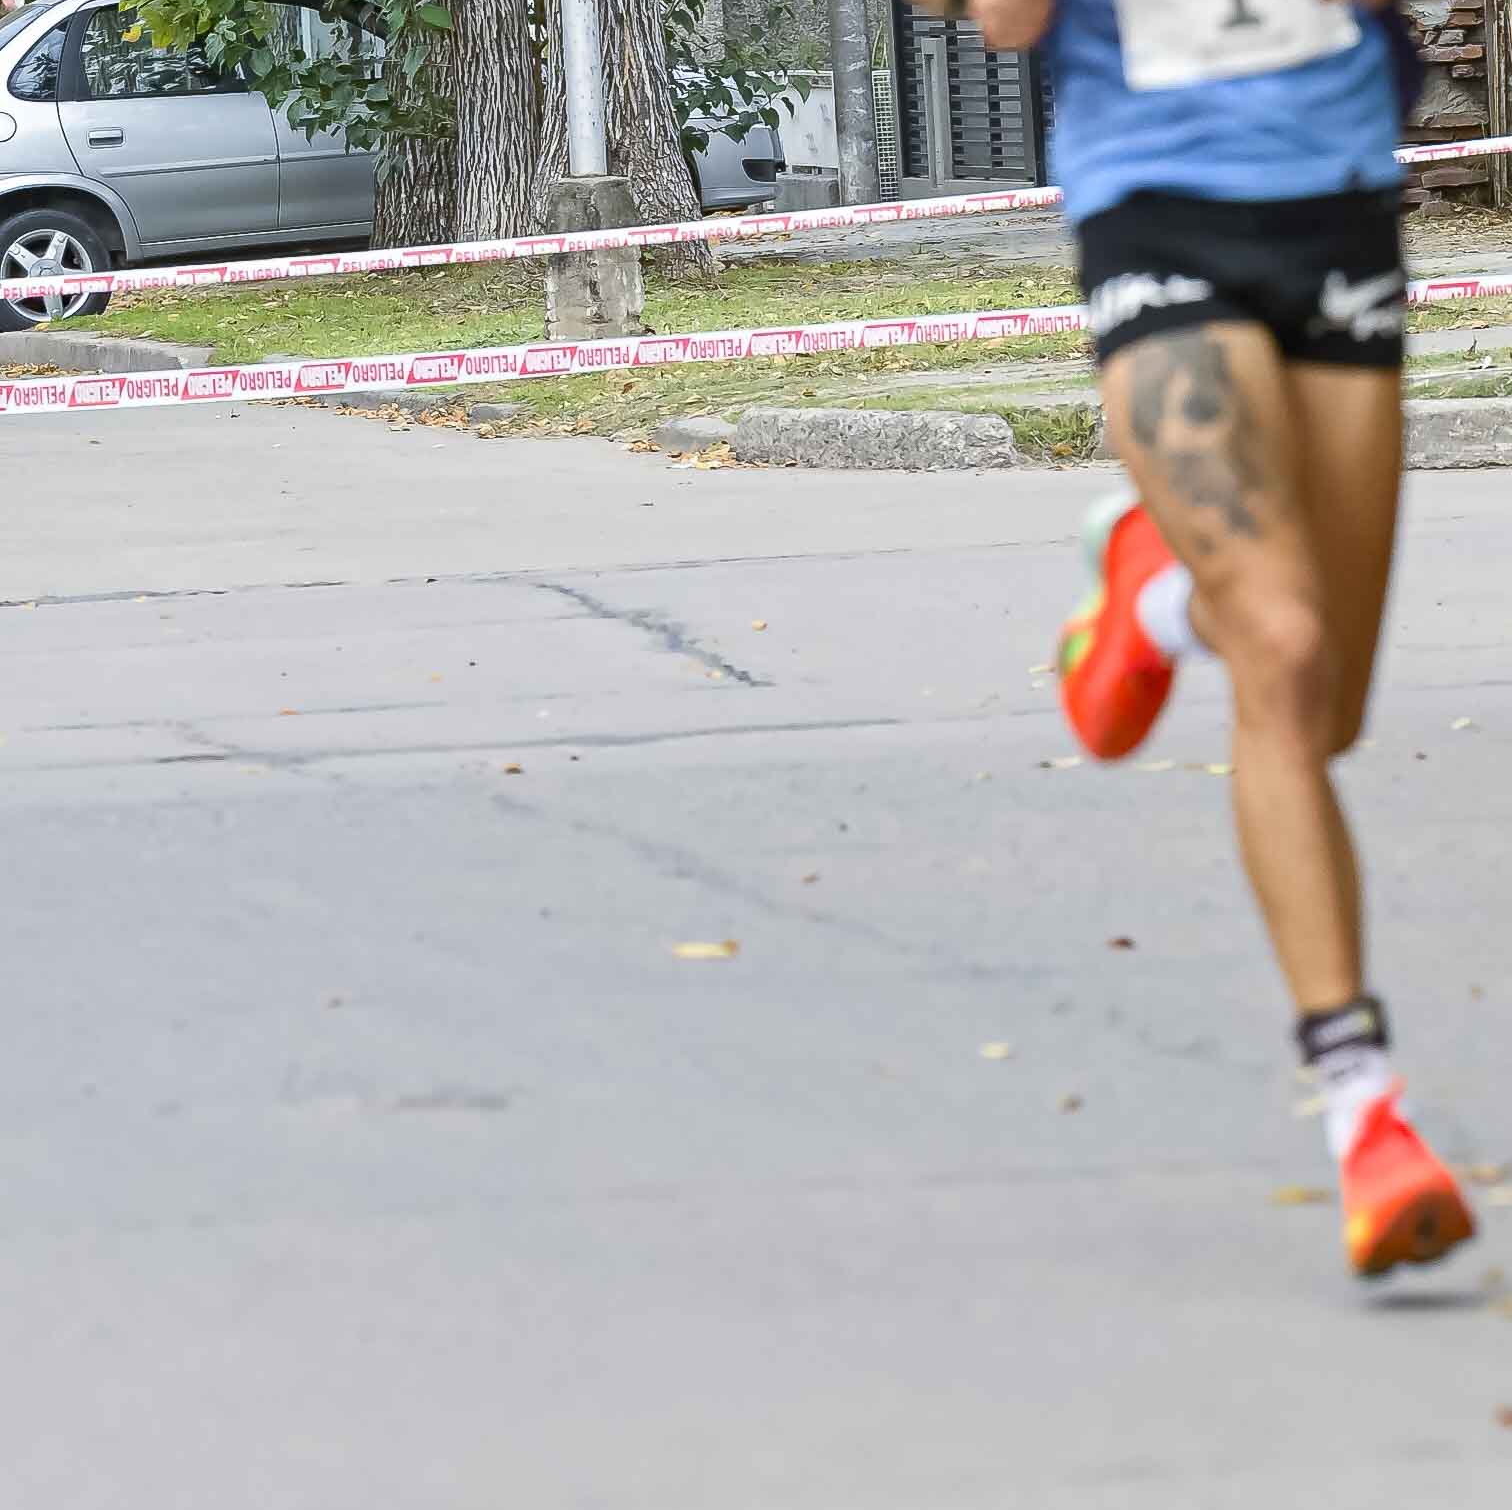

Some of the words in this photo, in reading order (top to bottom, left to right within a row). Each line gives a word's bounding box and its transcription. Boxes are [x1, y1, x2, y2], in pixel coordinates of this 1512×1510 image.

[14, 386, 66, 407] PELIGRO
[127, 377, 179, 399] PELIGRO
[240, 369, 292, 390] PELIGRO
[352, 362, 405, 382] PELIGRO
[465, 354, 517, 374] PELIGRO
[578, 345, 630, 367] PELIGRO
[691, 338, 743, 359] PELIGRO
